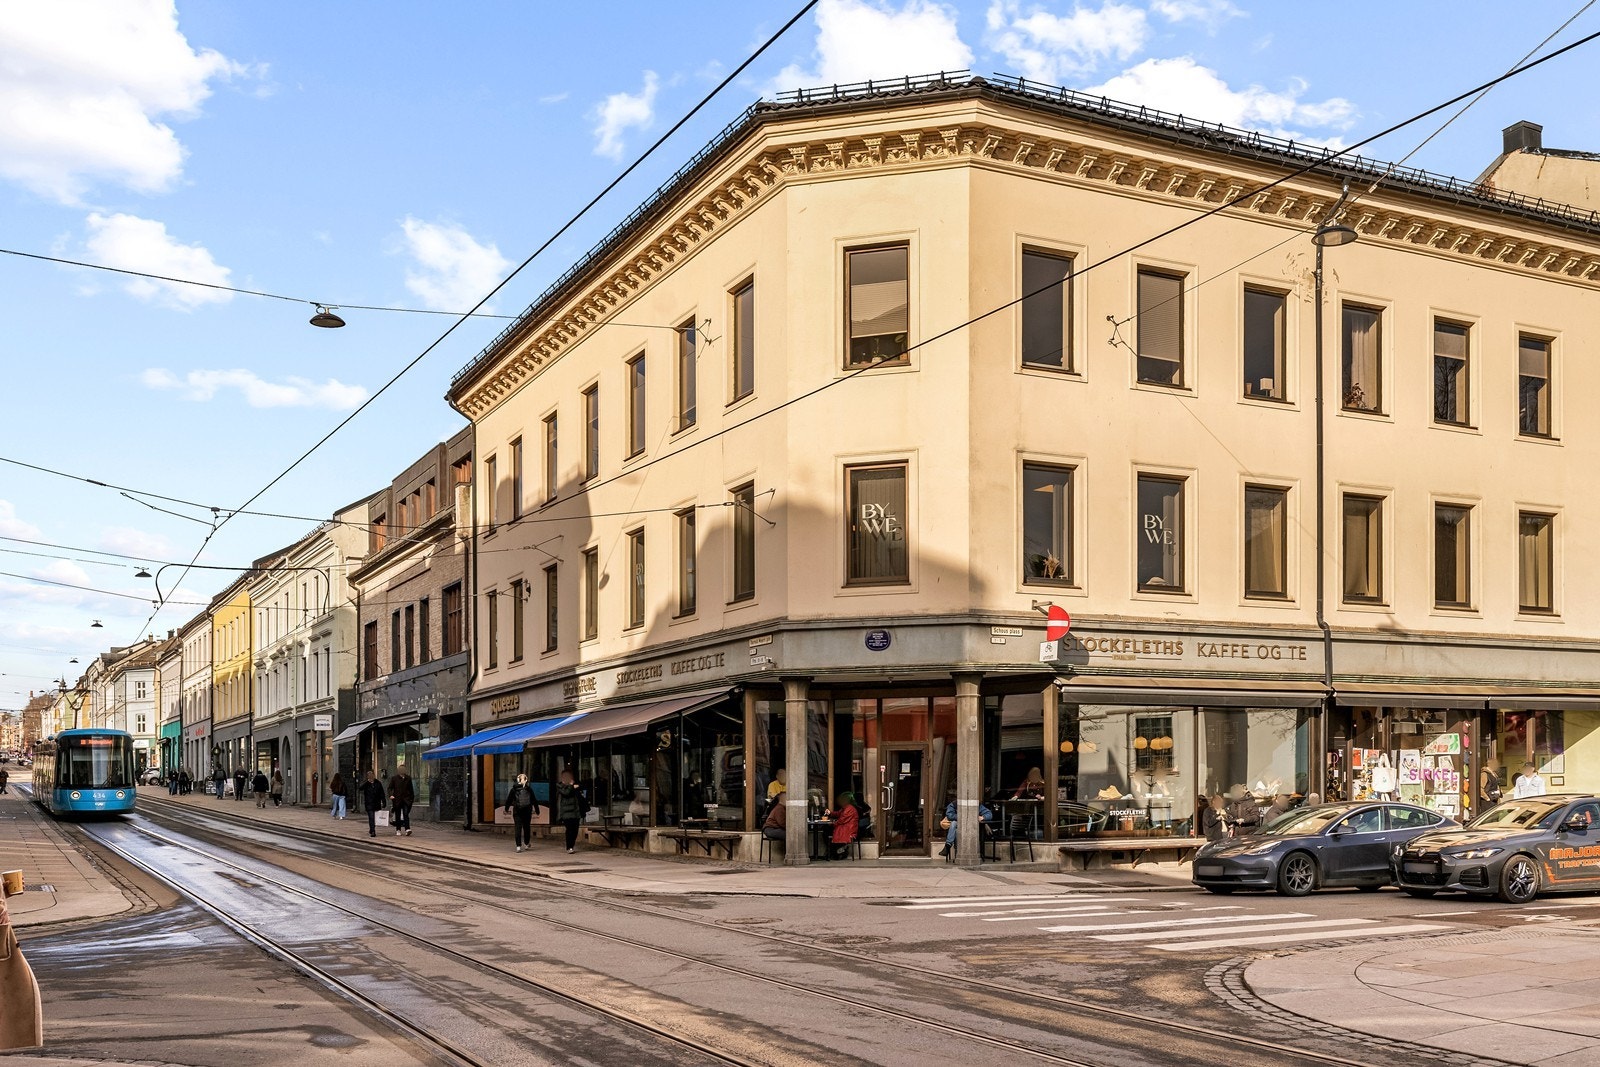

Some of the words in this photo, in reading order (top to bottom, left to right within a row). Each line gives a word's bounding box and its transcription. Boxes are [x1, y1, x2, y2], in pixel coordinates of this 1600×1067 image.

[861, 502, 890, 519] BY
[1144, 514, 1167, 529] BY
[1063, 636, 1184, 656] STOCKFLETHS
[1197, 642, 1250, 659] KAFFE
[1257, 644, 1281, 660] OG
[1288, 645, 1307, 661] TE
[670, 658, 696, 676] KAFFE
[696, 654, 712, 671] OG
[715, 652, 725, 668] TE
[490, 694, 520, 719] squeeze
[1409, 768, 1458, 781] SIRKEL
